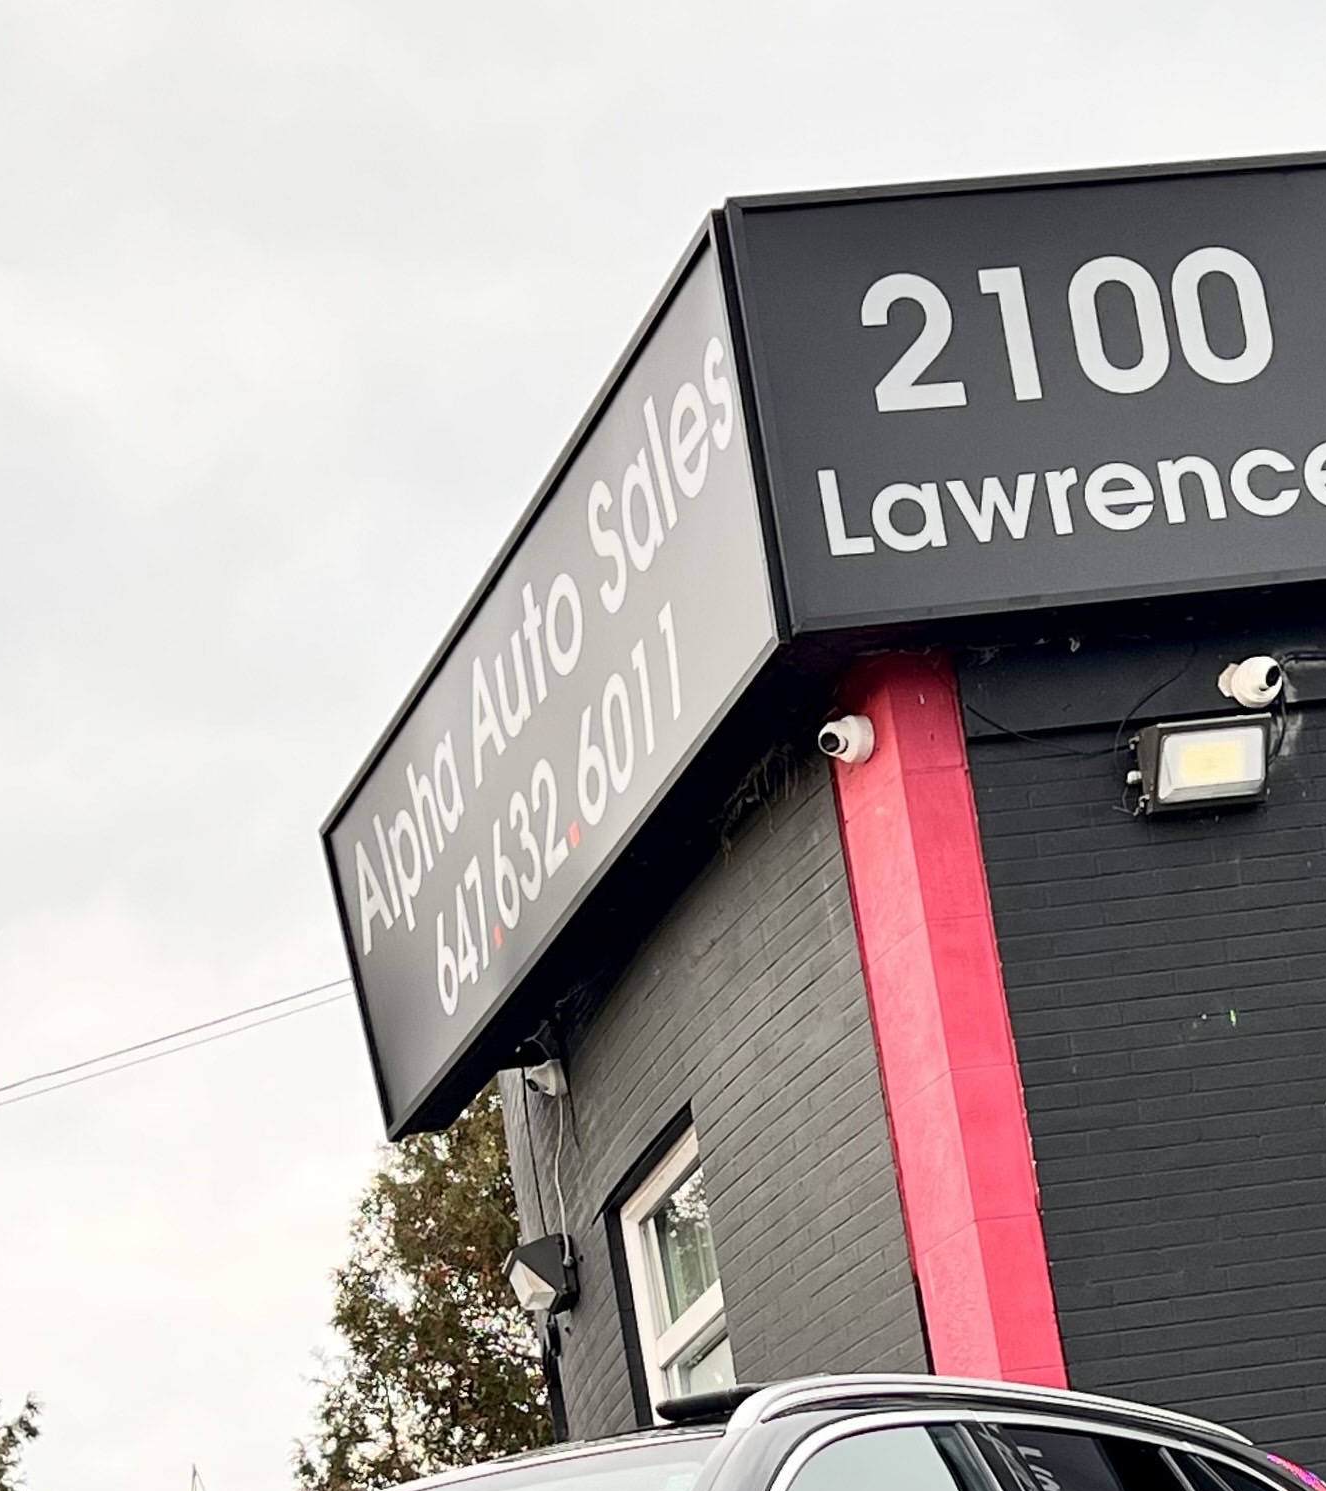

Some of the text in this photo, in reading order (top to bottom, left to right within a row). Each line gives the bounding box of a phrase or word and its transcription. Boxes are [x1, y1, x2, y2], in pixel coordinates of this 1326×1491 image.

[861, 246, 1273, 412] 2100
[355, 336, 733, 956] Alpha Auto Sales
[436, 601, 681, 1016] 647.632.6011
